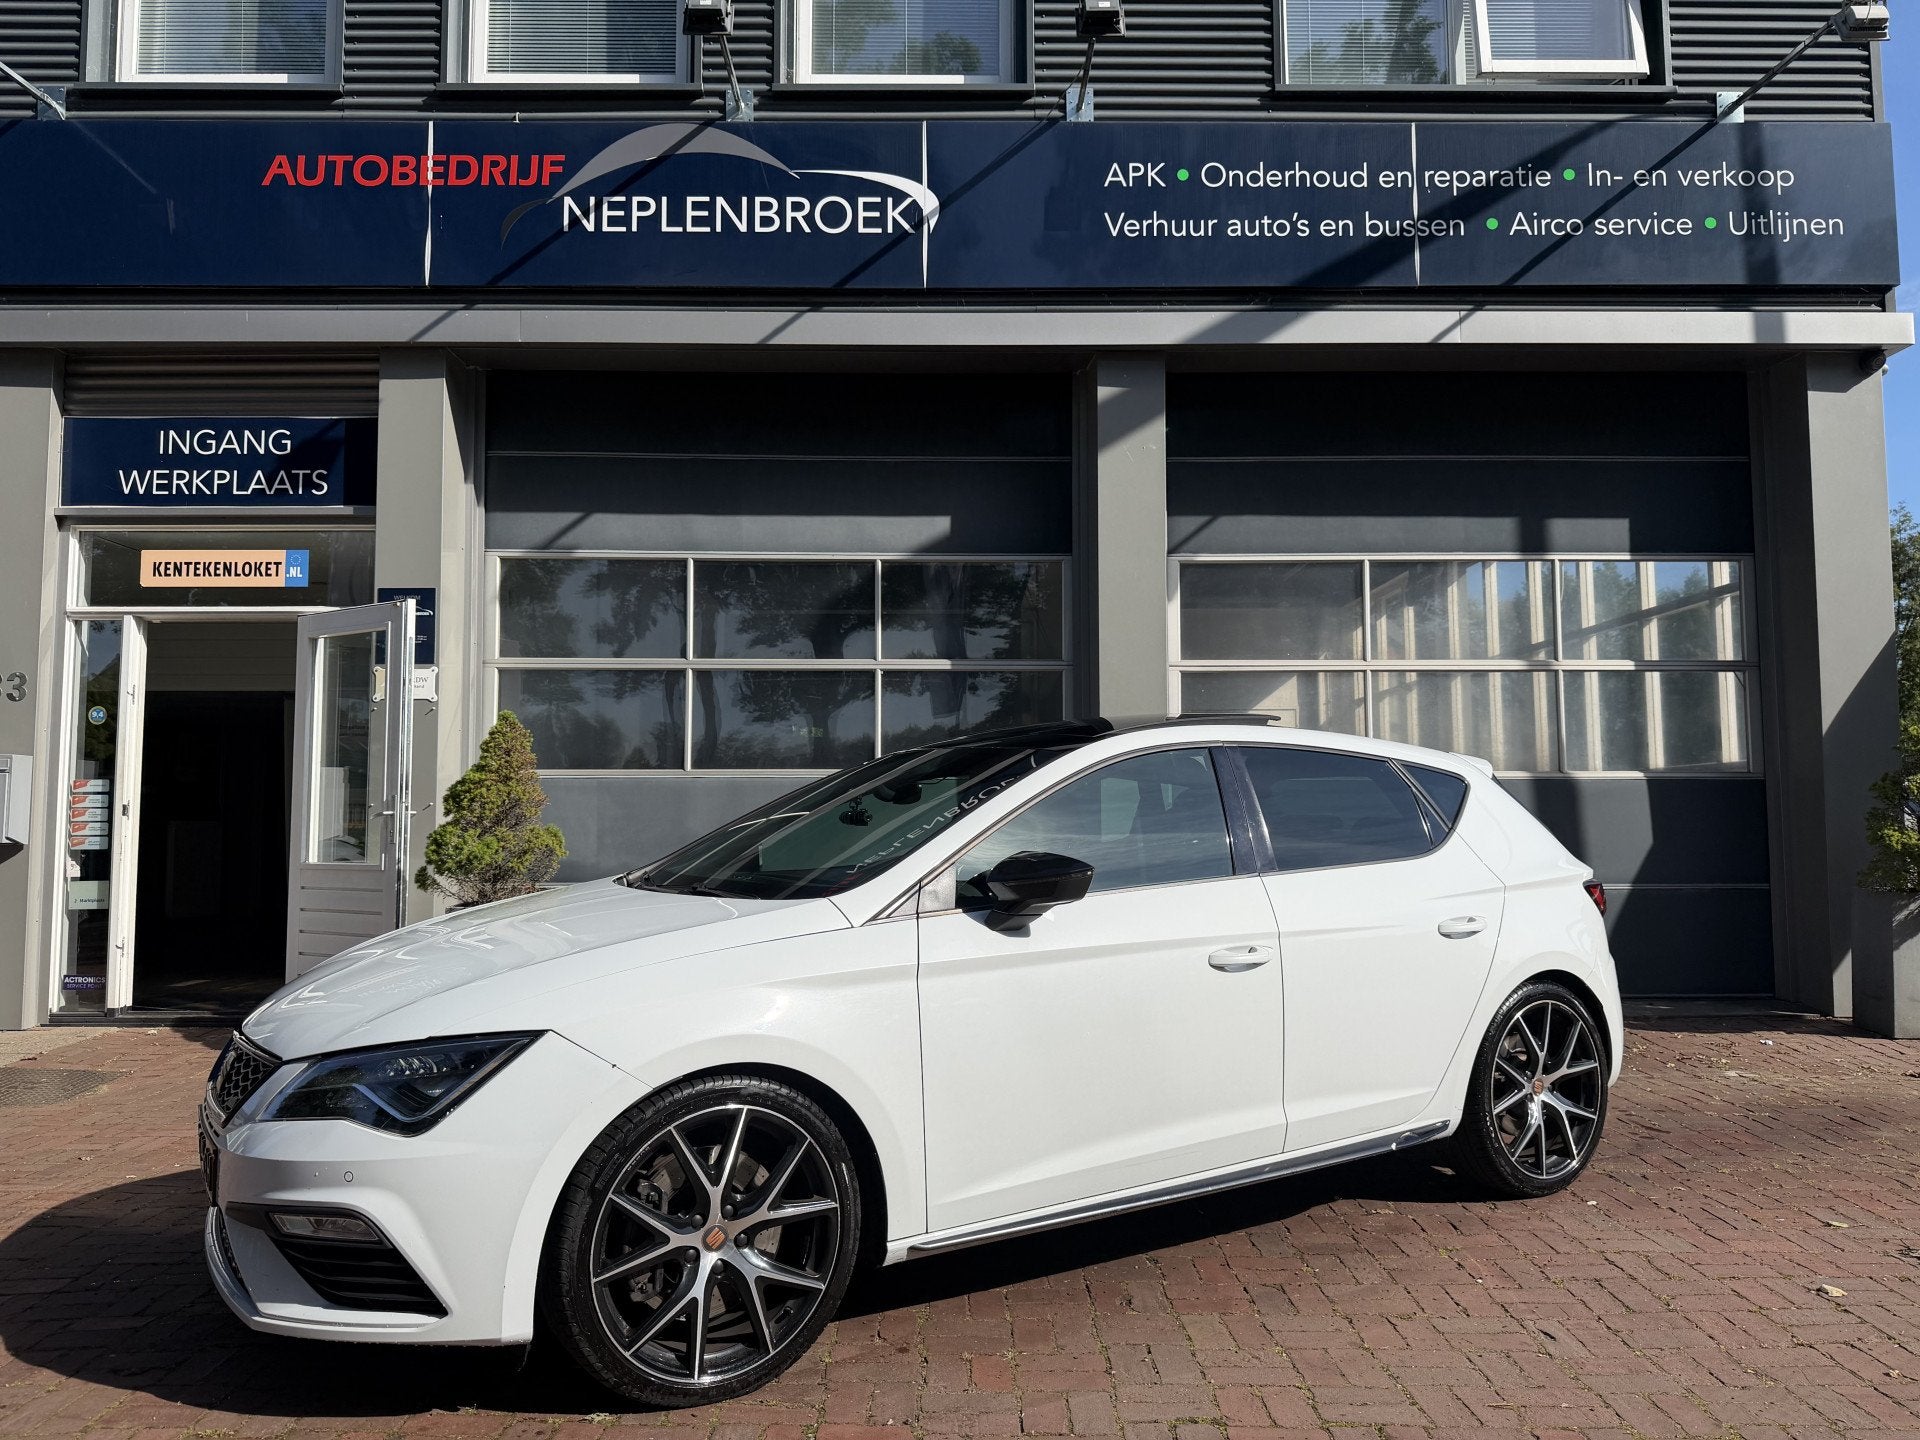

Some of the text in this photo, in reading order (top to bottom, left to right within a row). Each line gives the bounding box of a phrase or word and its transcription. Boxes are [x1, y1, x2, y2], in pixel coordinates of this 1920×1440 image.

[261, 155, 566, 187] AUTOBEDRIJF
[1103, 160, 1795, 197] APK Onderhoud en reparatie In- en verkoop
[562, 194, 916, 234] NEPLENBROEK
[1103, 210, 1219, 238] Verhuur
[1319, 219, 1355, 238] en
[1364, 210, 1466, 238] bussen
[1508, 211, 1584, 236] Airco
[1594, 211, 1693, 236] service
[1728, 209, 1844, 243] Uitlijnen
[159, 429, 293, 456] INGANG
[118, 469, 329, 496] WERKPLAATS
[152, 561, 283, 578] KENTEKENLOKET
[0, 672, 28, 702] 3
[64, 976, 106, 984] ACTRONICS
